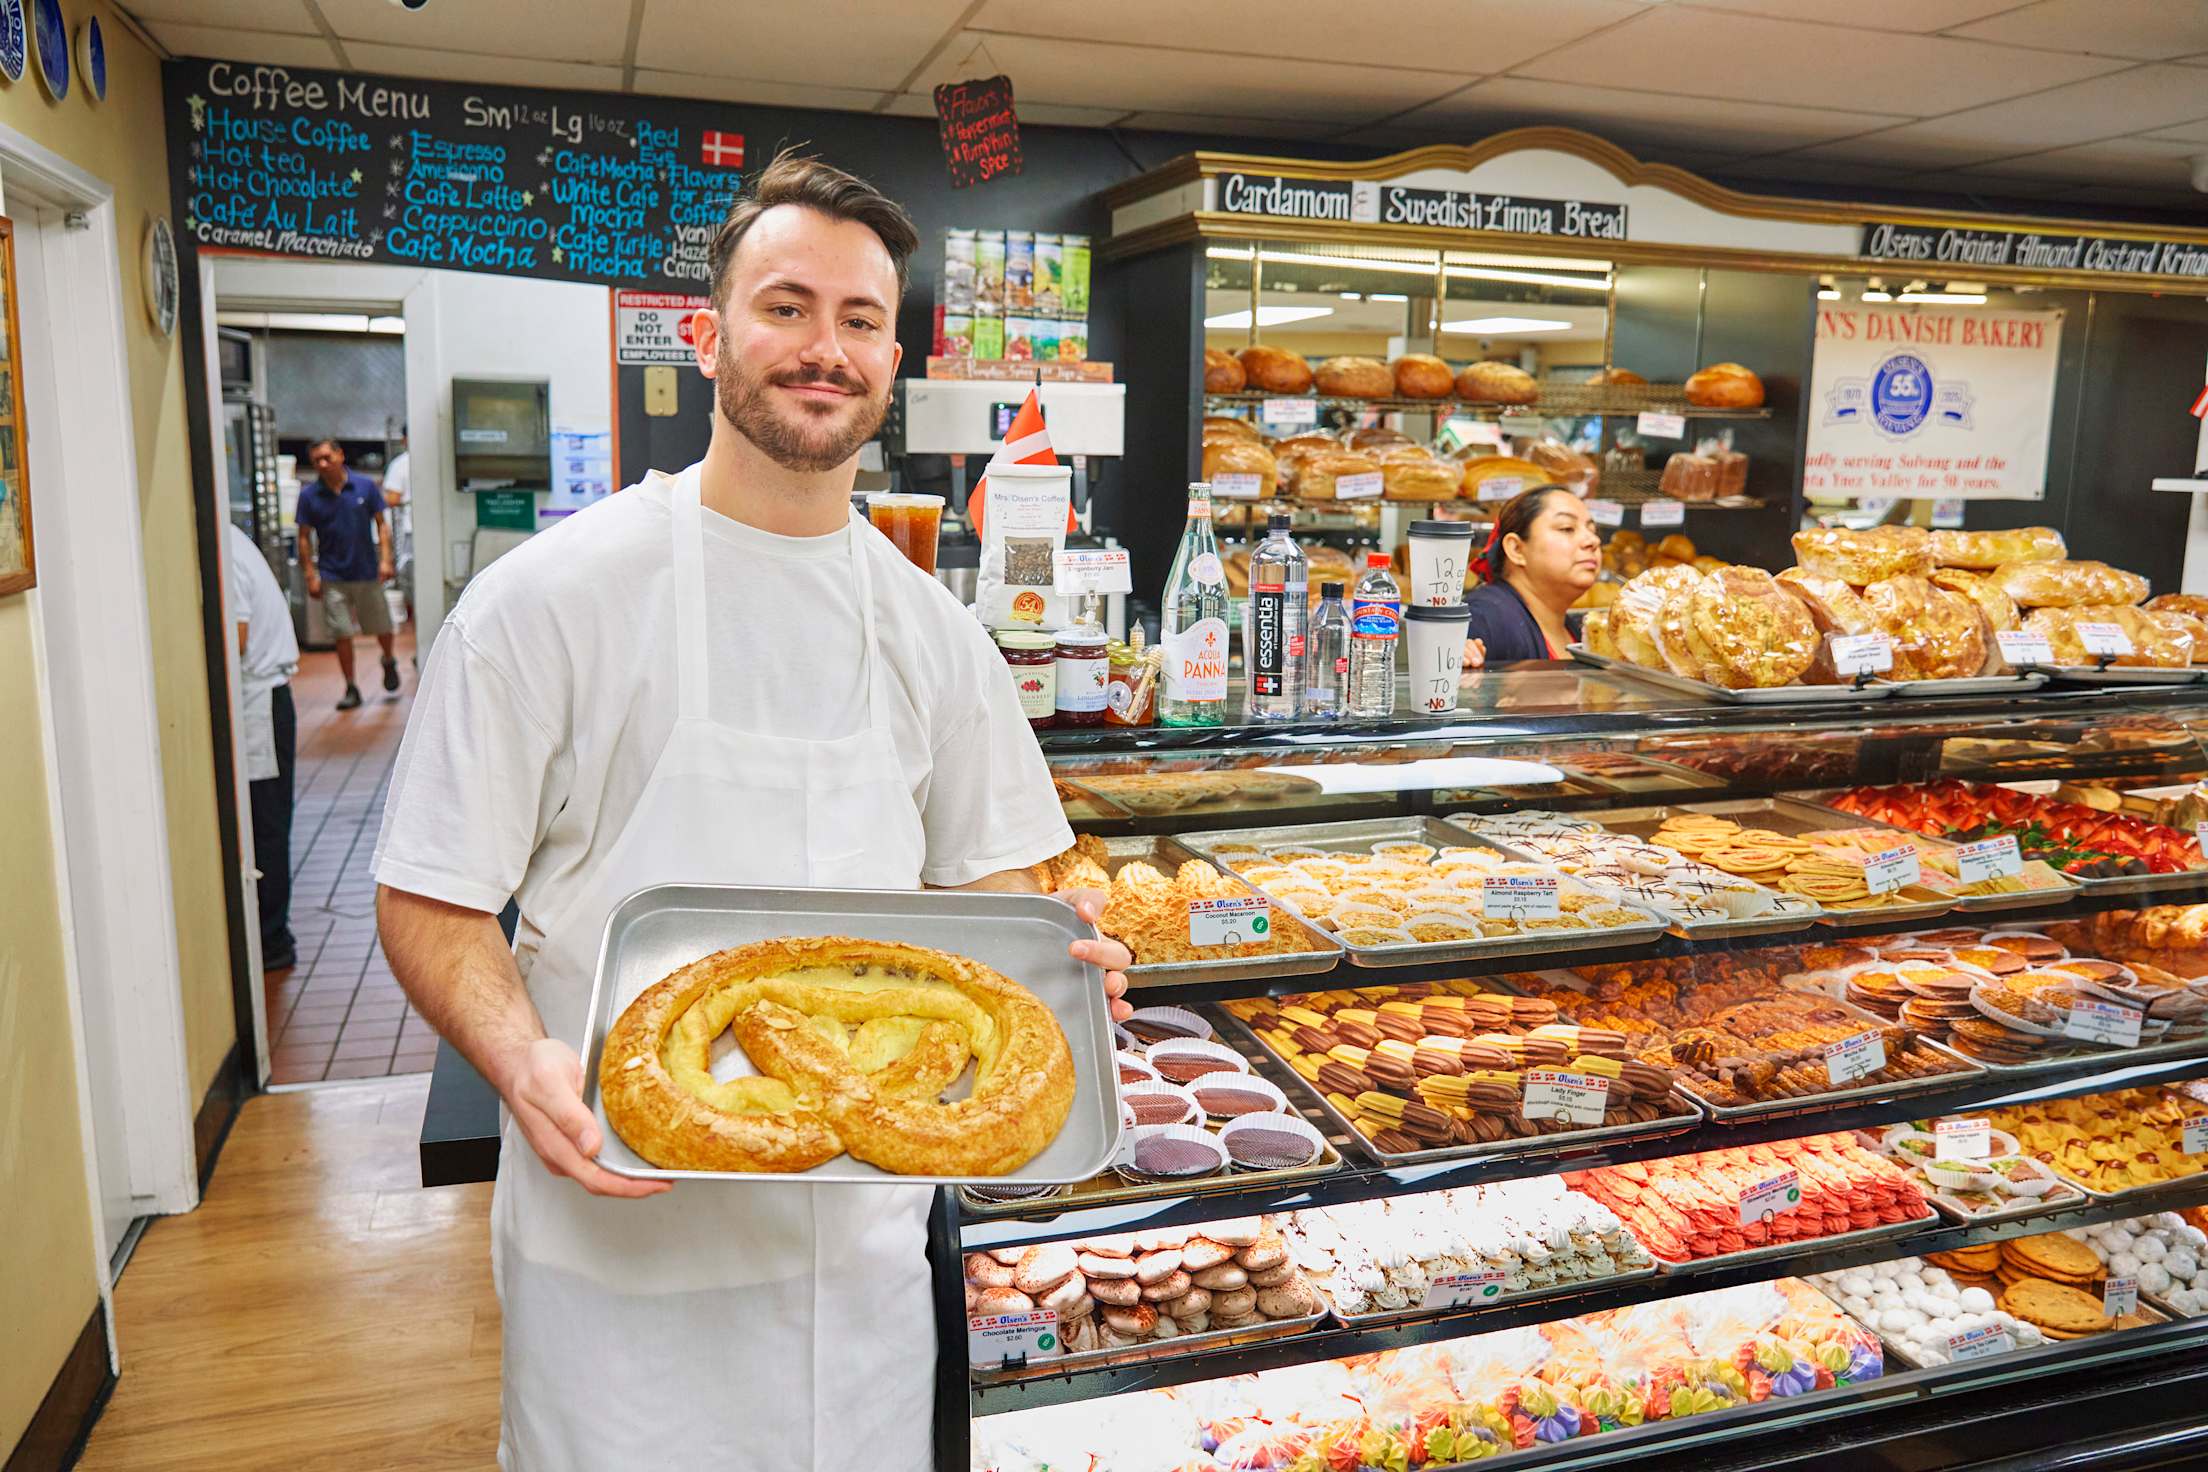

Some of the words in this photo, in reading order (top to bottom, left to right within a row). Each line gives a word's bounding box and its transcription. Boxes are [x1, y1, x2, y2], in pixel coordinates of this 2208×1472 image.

[208, 62, 329, 112] Coffee
[338, 77, 431, 120] Menu
[205, 105, 288, 143] House
[291, 115, 373, 155] Coffee
[463, 95, 512, 131] Sm
[552, 104, 582, 144] Lg
[637, 120, 679, 148] Red
[201, 137, 254, 168] Hot
[261, 144, 306, 175] tea
[409, 129, 506, 167] Espresso
[640, 145, 676, 168] Eye
[406, 160, 504, 184] Americano
[554, 149, 599, 179] Cafe
[600, 154, 656, 181] Mocha
[667, 162, 740, 191] Flavors
[979, 154, 1009, 180] Spice
[195, 164, 244, 192] Hot
[248, 167, 360, 200] Chocolate
[404, 179, 462, 208] Cafe
[464, 179, 524, 212] Latte
[551, 175, 611, 207] White
[615, 180, 660, 210] Cafe
[671, 183, 698, 206] for
[702, 189, 733, 208] any
[1225, 174, 1350, 221] Cardamom
[264, 197, 298, 233] Au
[305, 201, 361, 239] Lait
[402, 204, 548, 241] Cappuccino
[570, 203, 646, 229] Mocha
[669, 202, 728, 226] Coffee
[1385, 186, 1482, 230] Swedish
[1560, 201, 1626, 240] Bread
[272, 227, 375, 259] Macchiato
[388, 226, 443, 263] Cafe
[449, 232, 539, 270] Mocha
[556, 223, 610, 254] Cafe
[610, 229, 663, 258] Turtle
[674, 224, 721, 245] Vanill
[1869, 223, 1935, 260] Olsens
[1936, 229, 2013, 265] Original
[2014, 233, 2086, 269] Almond
[2083, 239, 2162, 273] Custard
[568, 249, 648, 279] Mocha
[634, 324, 662, 333] NOT
[638, 312, 659, 322] DO
[1818, 311, 1858, 340] N'S
[1866, 312, 1954, 345] DANISH
[1962, 317, 2048, 350] BAKERY
[626, 335, 672, 345] ENTER
[1843, 455, 1893, 471] serving
[1898, 453, 1950, 472] Solvang
[1955, 456, 1981, 471] and
[1985, 456, 2006, 471] the
[1870, 474, 1911, 489] Valley
[1916, 475, 1937, 488] for
[1435, 557, 1454, 579] 12
[1428, 581, 1449, 594] TO
[1258, 597, 1273, 669] essentia
[1184, 659, 1225, 679] PANNA
[1436, 646, 1455, 673] 16
[1430, 679, 1450, 694] TO
[1509, 878, 1534, 886] Olsen's
[1216, 900, 1242, 909] Olsen's
[1551, 1086, 1566, 1095] Lady
[1566, 1088, 1587, 1097] Finger
[1558, 1074, 1584, 1086] Olsen's
[982, 1328, 1015, 1337] Chocolate
[1016, 1325, 1046, 1335] Meringue
[1000, 1315, 1027, 1324] Olsen's
